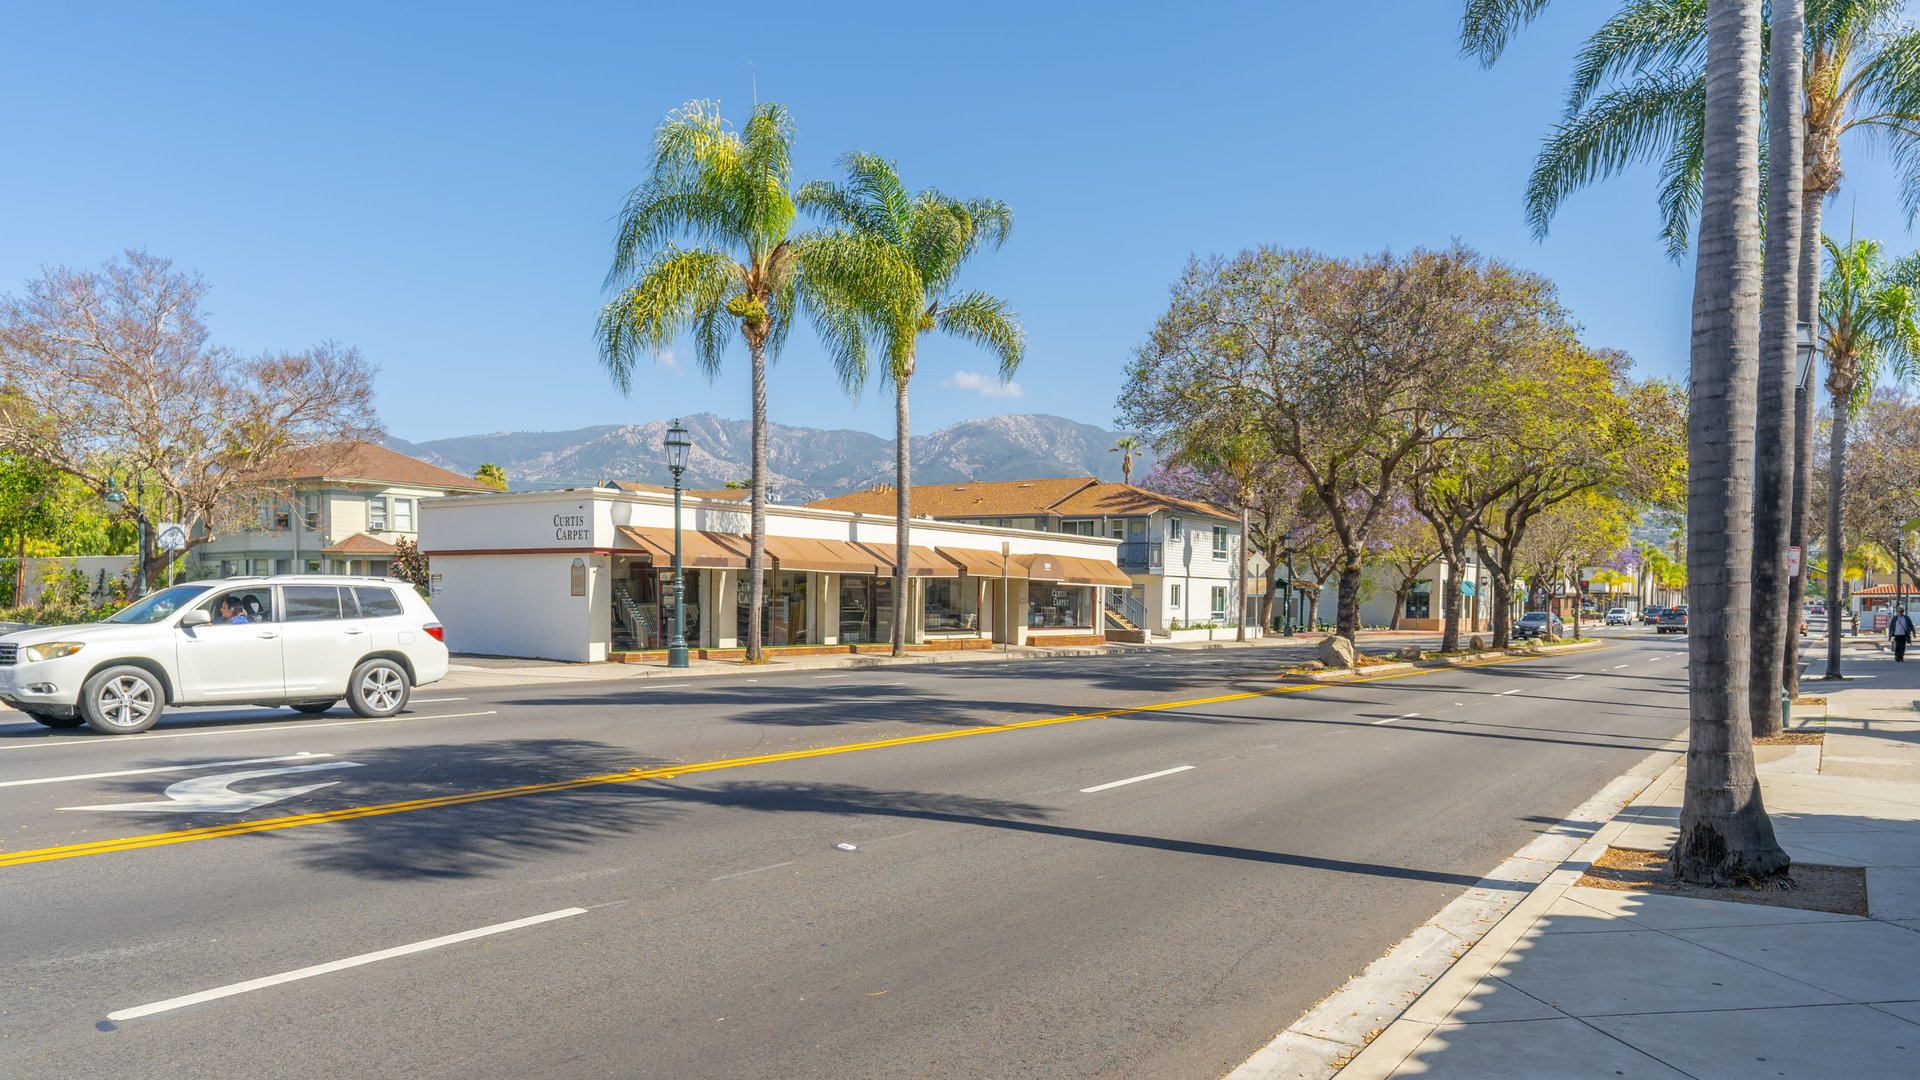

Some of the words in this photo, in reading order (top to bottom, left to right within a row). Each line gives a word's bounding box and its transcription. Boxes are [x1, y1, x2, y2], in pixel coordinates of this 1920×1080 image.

[554, 514, 584, 527] CURTIS
[556, 528, 589, 540] CARPET
[738, 592, 768, 604] CAT
